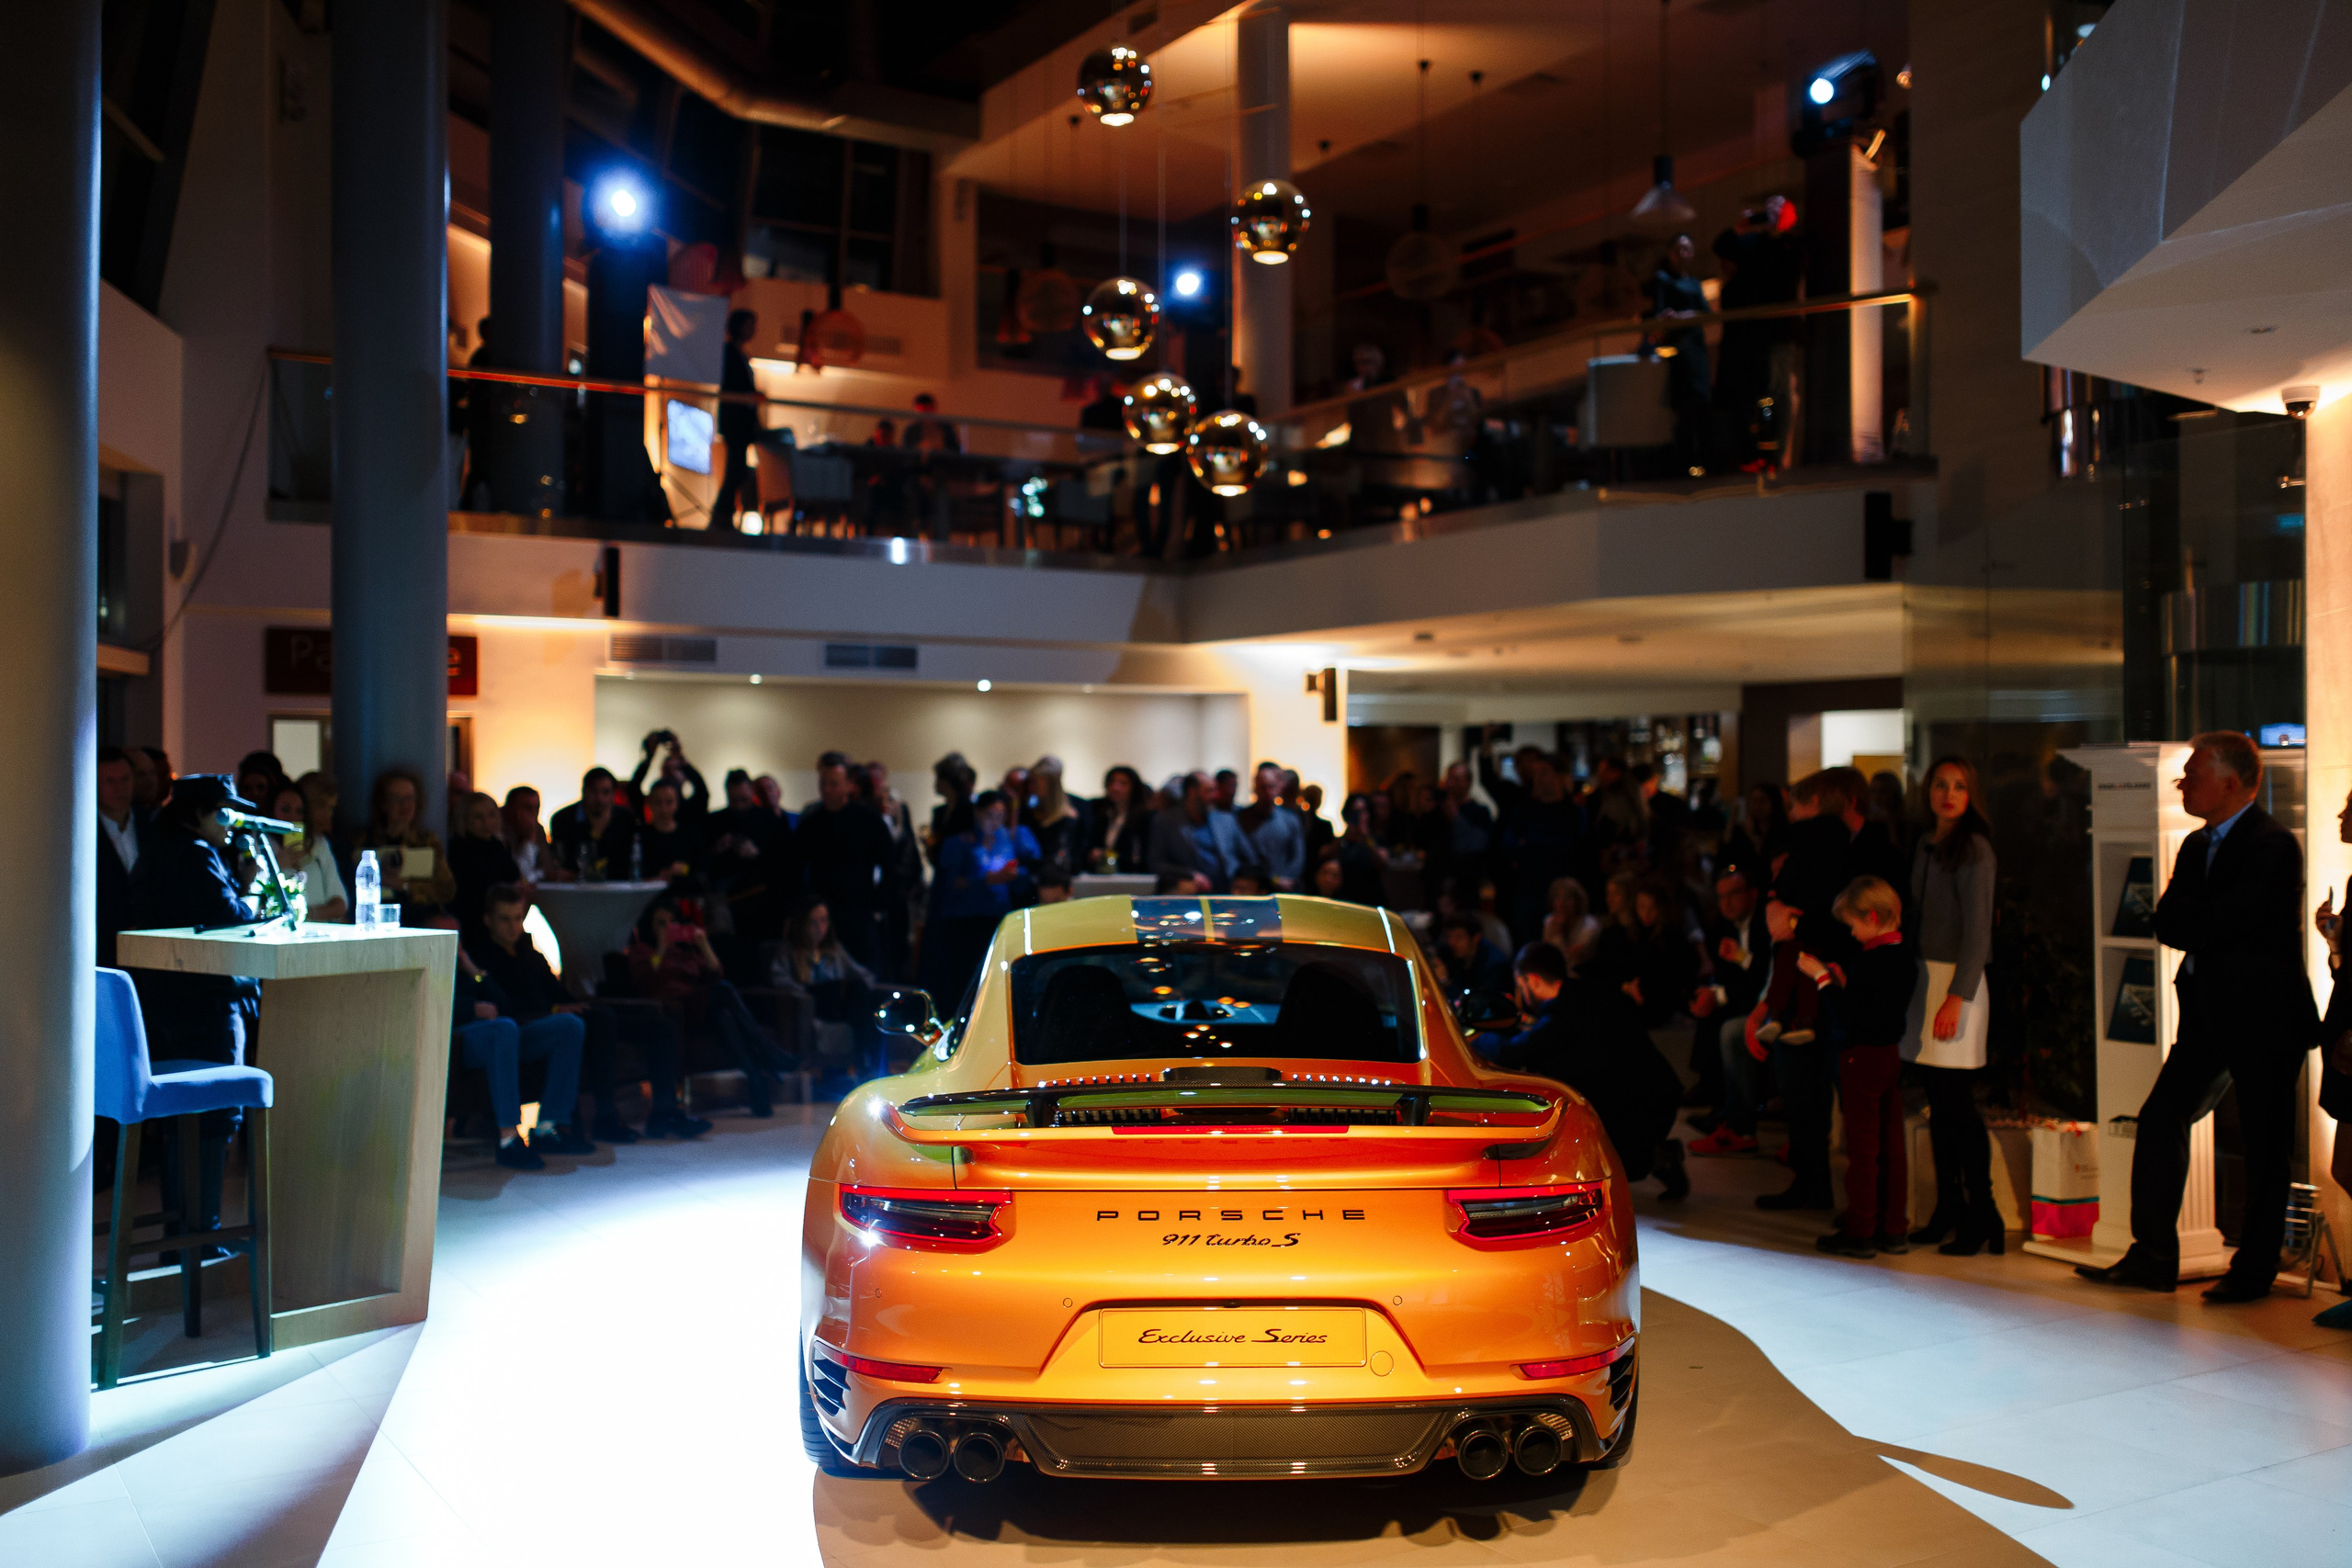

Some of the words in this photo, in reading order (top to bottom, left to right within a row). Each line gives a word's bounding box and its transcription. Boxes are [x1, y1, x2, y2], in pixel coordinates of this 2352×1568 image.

[1097, 1210, 1365, 1221] PORSCHE
[1162, 1234, 1201, 1247] 911
[1205, 1234, 1272, 1247] turbo
[1271, 1233, 1301, 1247] S
[1138, 1328, 1246, 1343] Exclusive
[1251, 1328, 1328, 1343] Series
